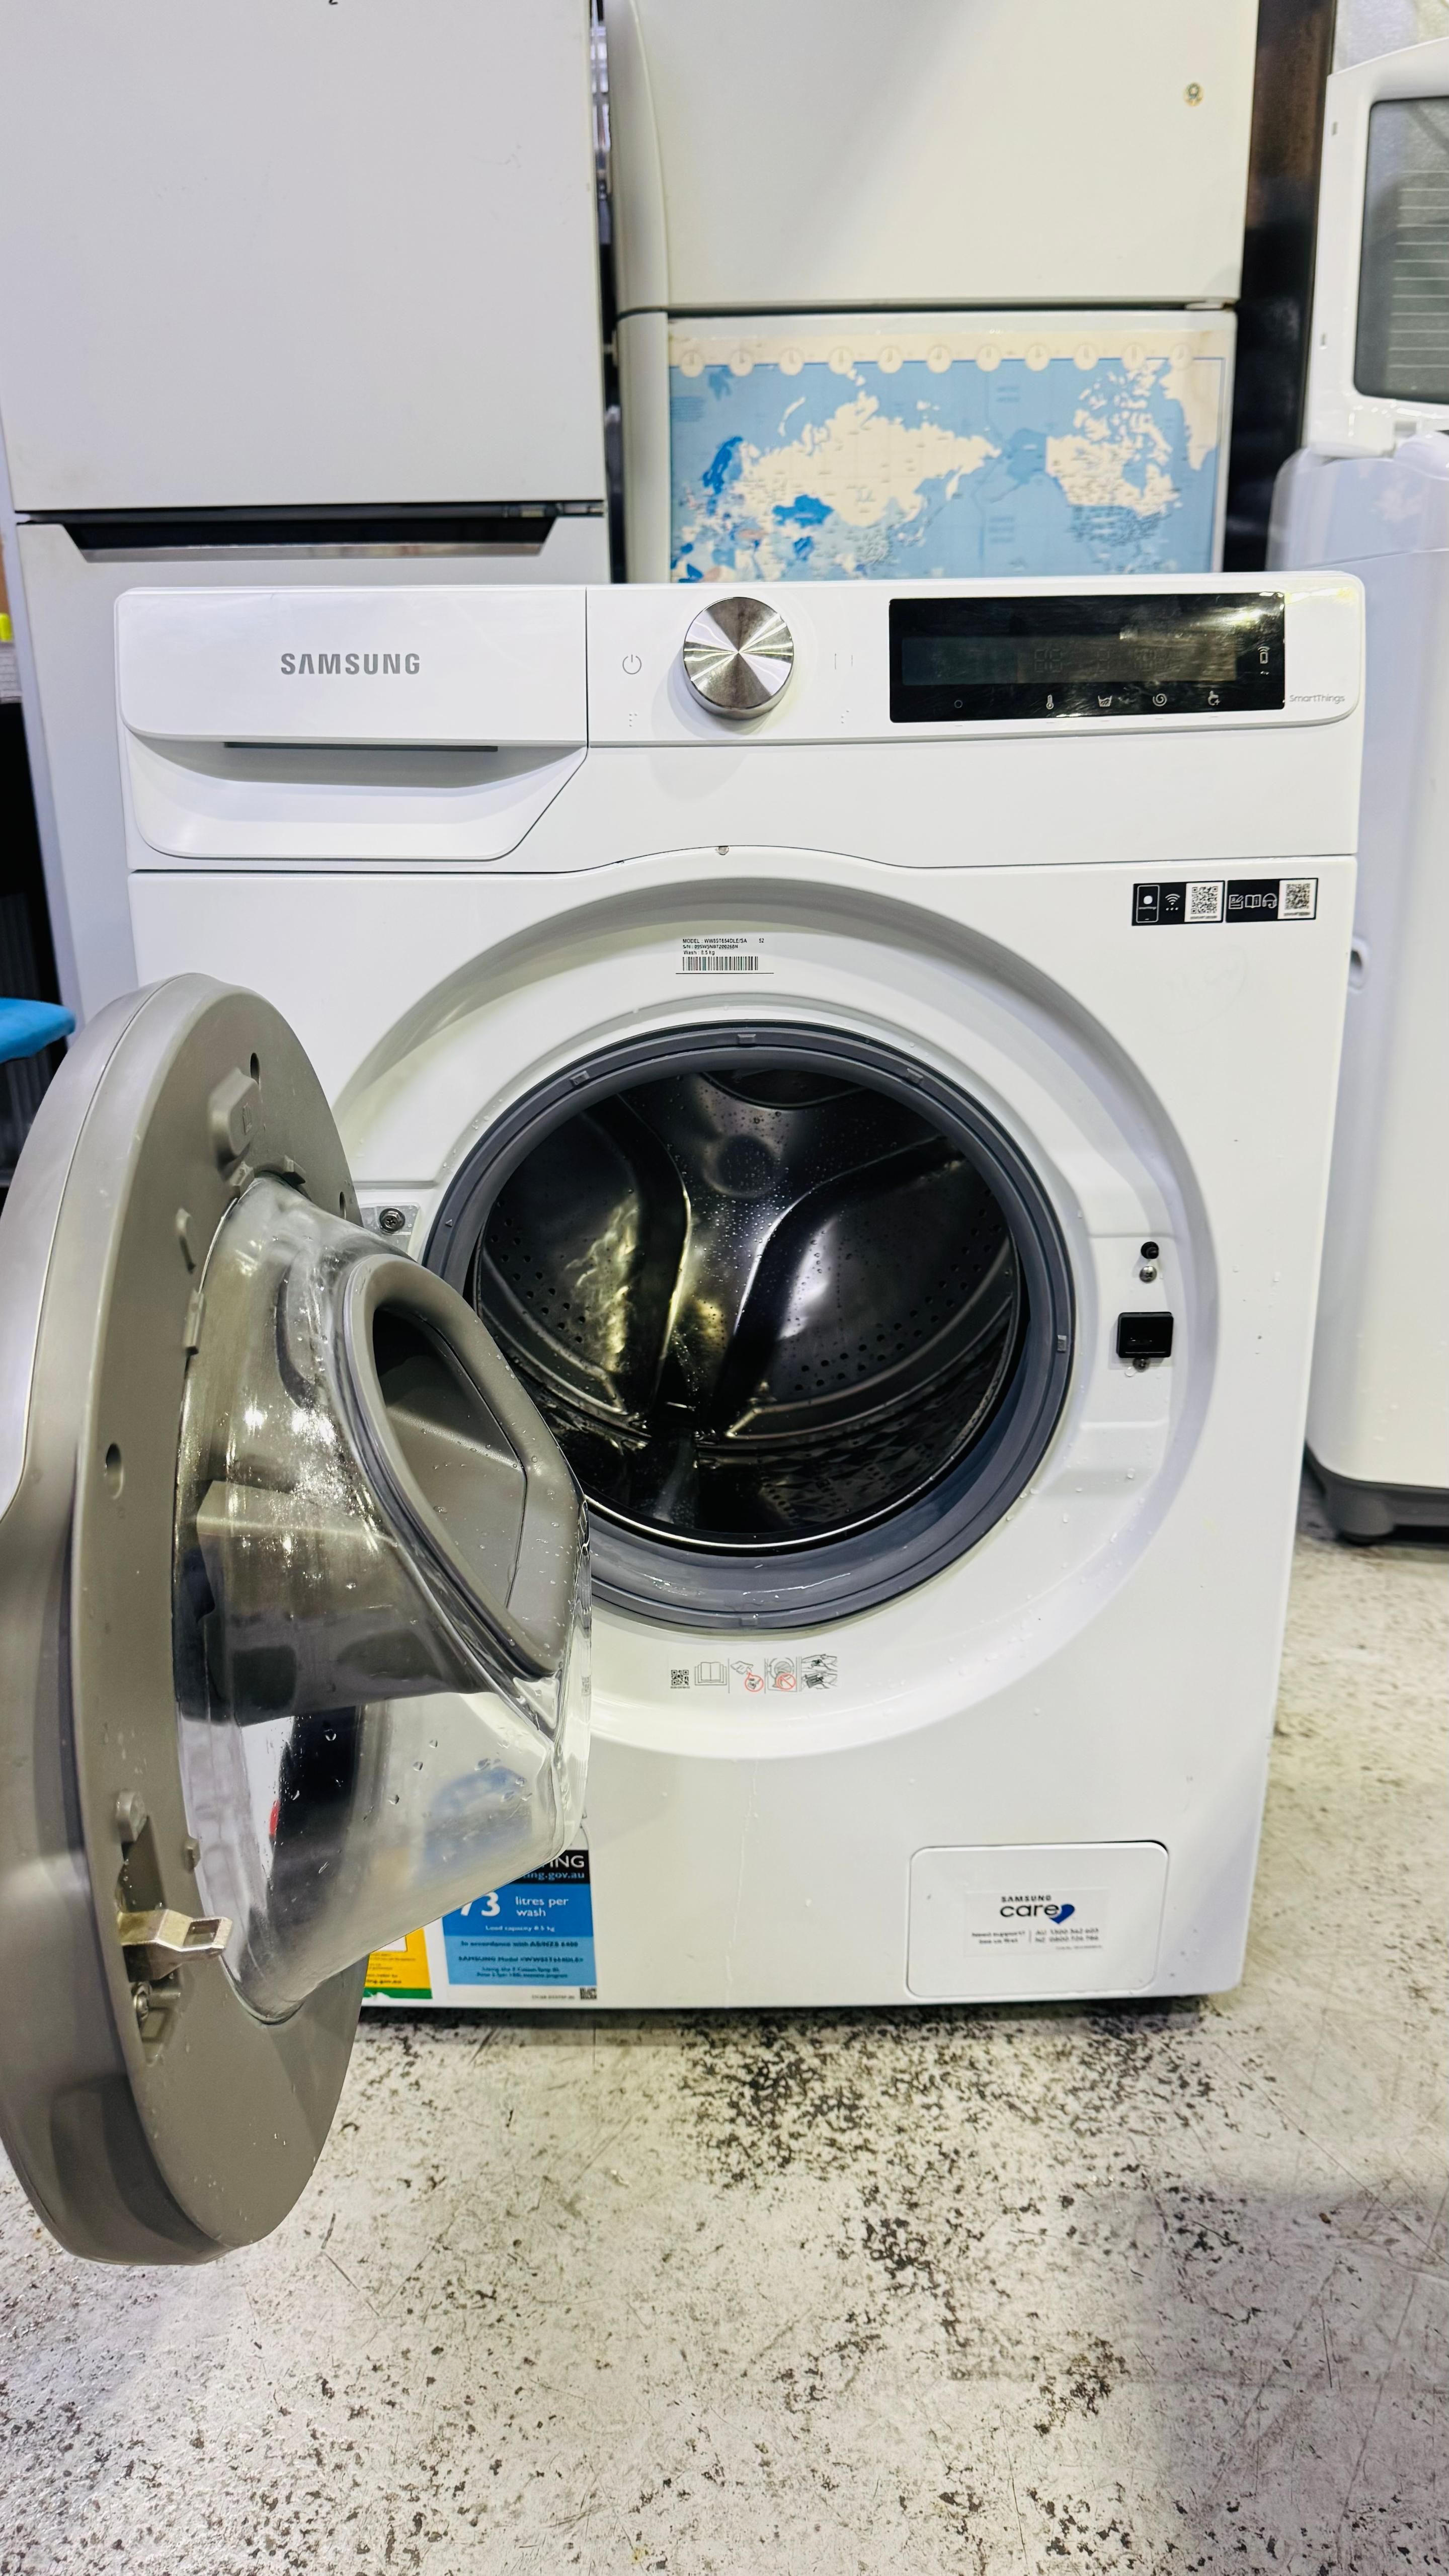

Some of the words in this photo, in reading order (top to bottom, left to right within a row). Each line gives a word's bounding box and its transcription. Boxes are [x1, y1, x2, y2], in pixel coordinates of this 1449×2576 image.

[281, 653, 420, 675] SAMSUNG
[1289, 694, 1345, 704] SmartThings
[542, 1855, 585, 1869] ING
[515, 1896, 545, 1906] litres
[548, 1899, 569, 1908] per
[516, 1908, 546, 1917] wash
[1000, 1904, 1059, 1917] care
